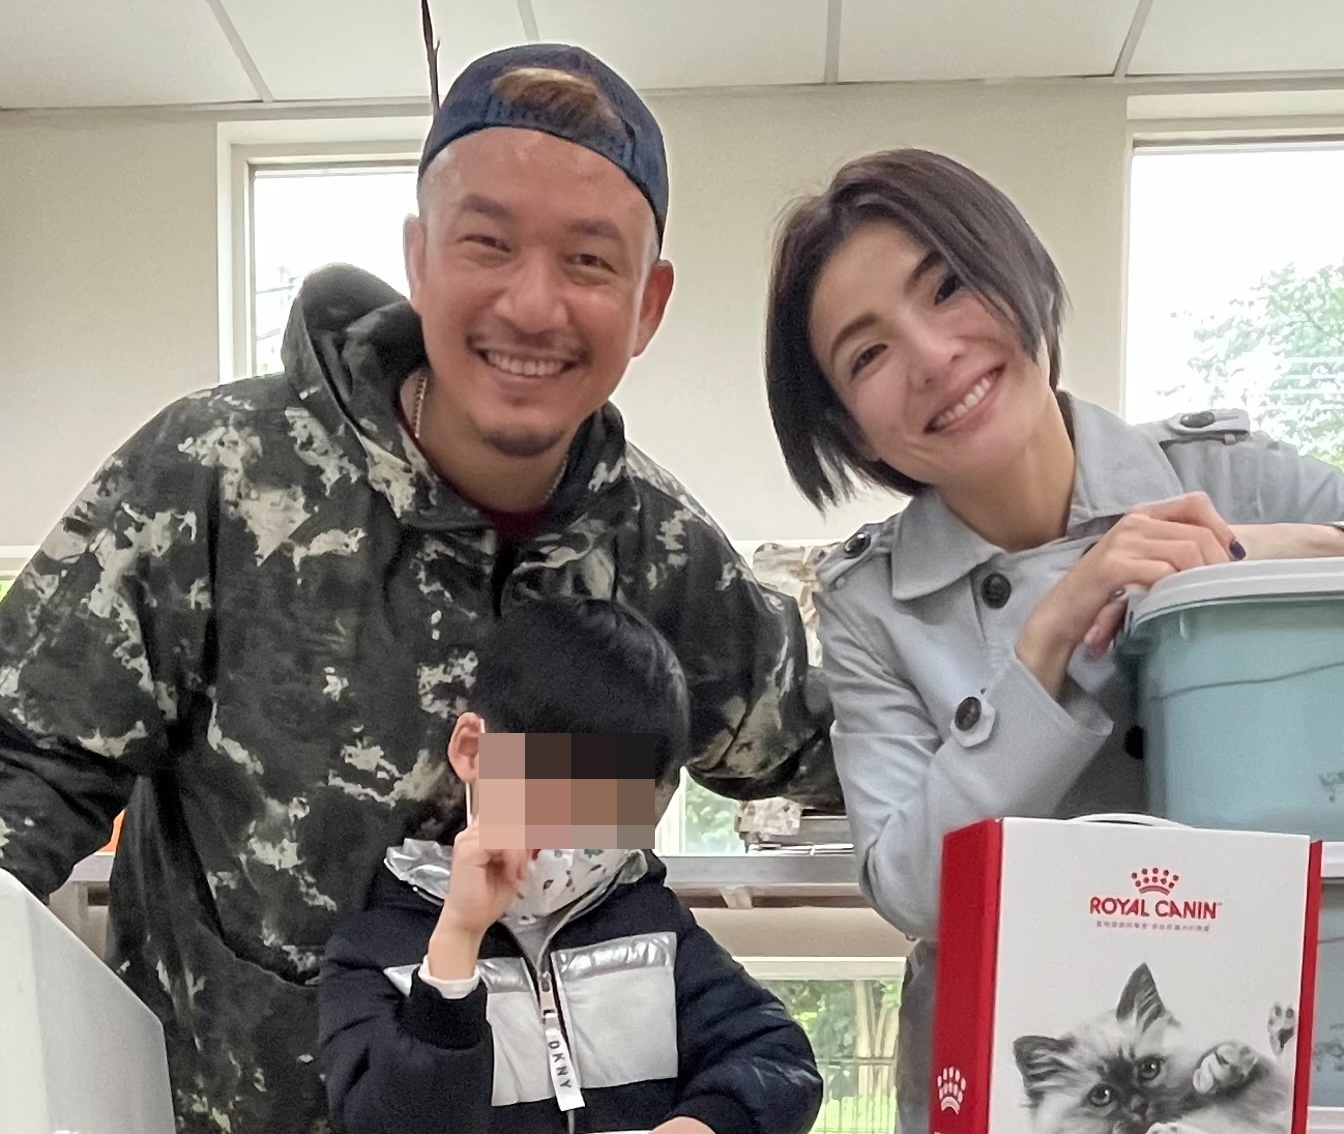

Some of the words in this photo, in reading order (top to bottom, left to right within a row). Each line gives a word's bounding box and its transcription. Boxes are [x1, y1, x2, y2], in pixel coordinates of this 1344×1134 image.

[1090, 897, 1150, 917] ROYAL
[1155, 900, 1217, 919] CANIN
[548, 1040, 572, 1089] DKNY
